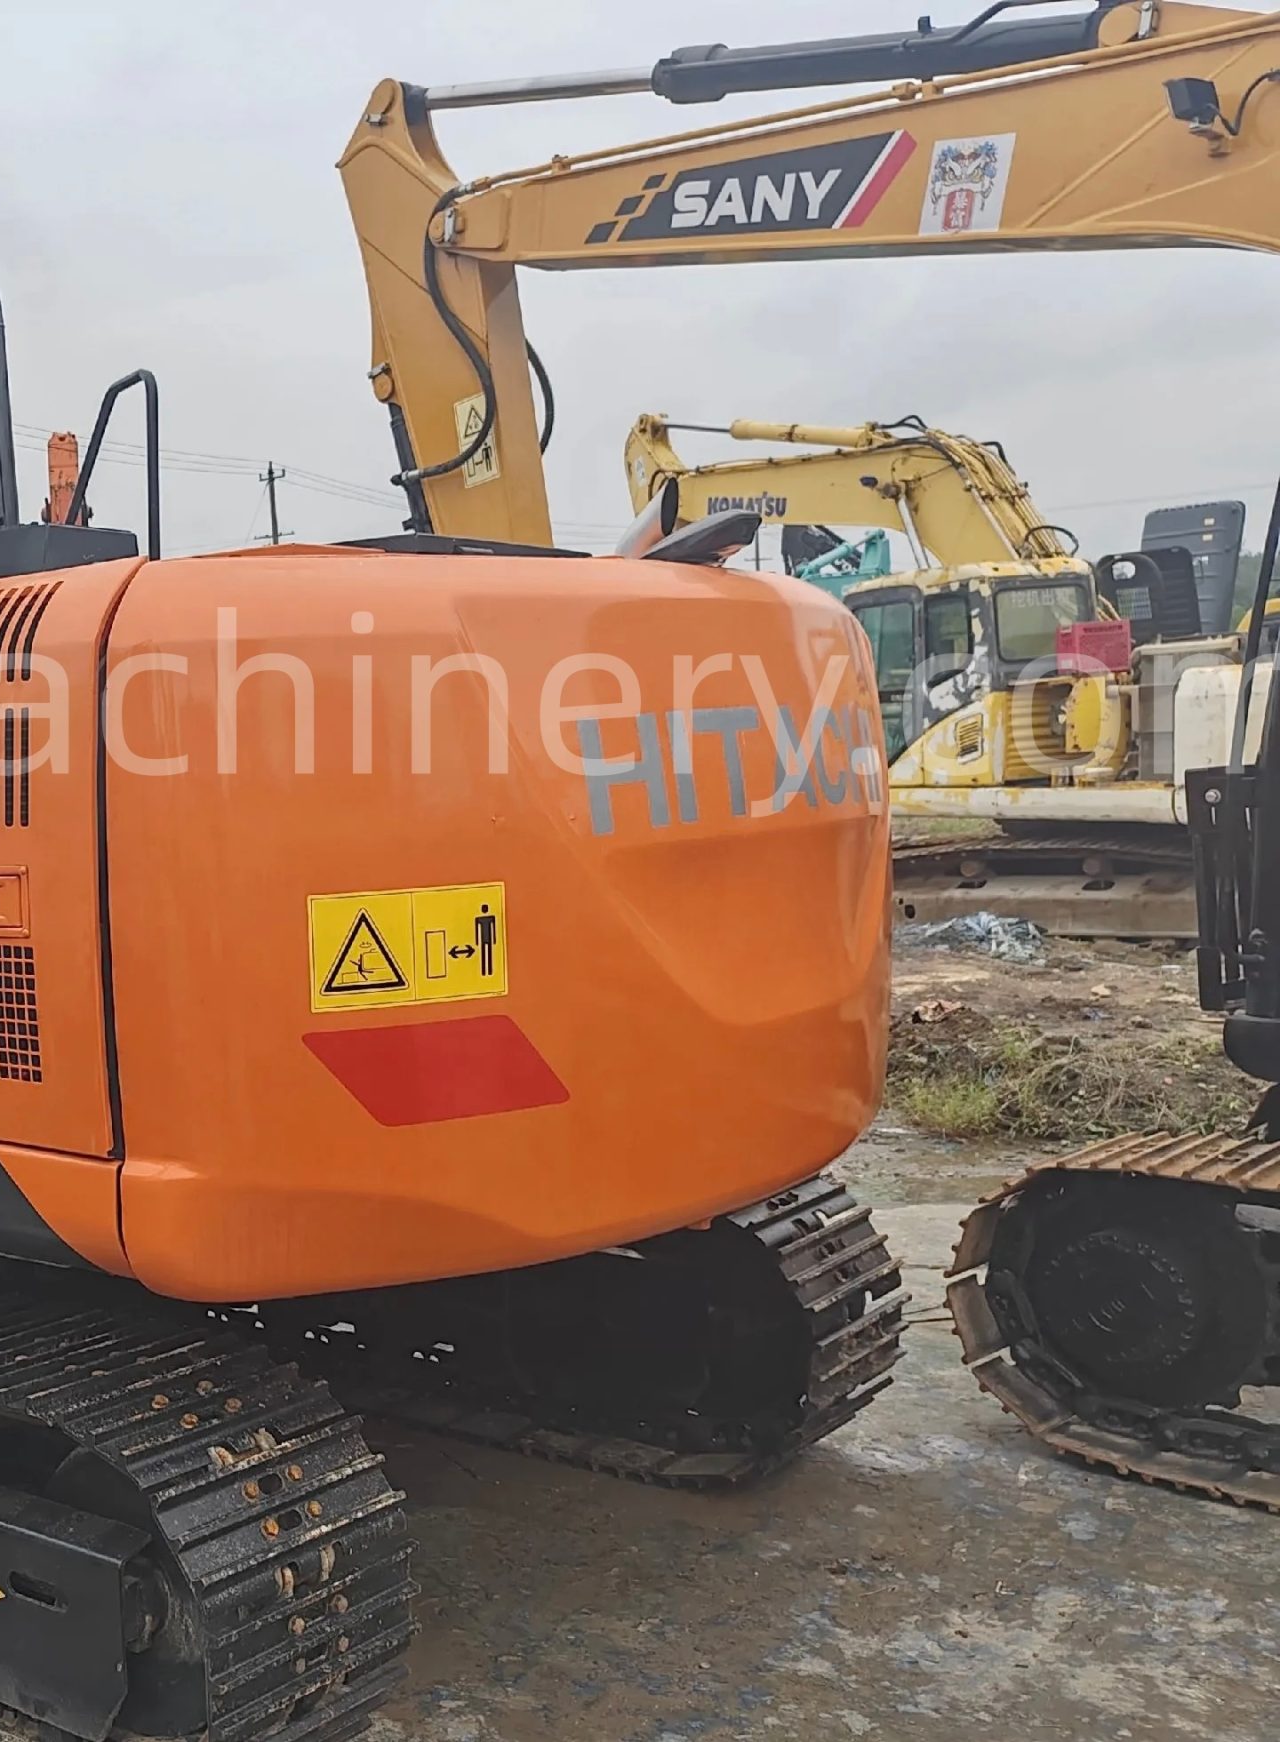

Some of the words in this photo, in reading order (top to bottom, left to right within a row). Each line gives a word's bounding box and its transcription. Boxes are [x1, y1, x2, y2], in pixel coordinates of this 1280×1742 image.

[671, 168, 842, 228] SANY
[707, 491, 787, 517] KOMATSU
[577, 704, 882, 836] HITACHI
